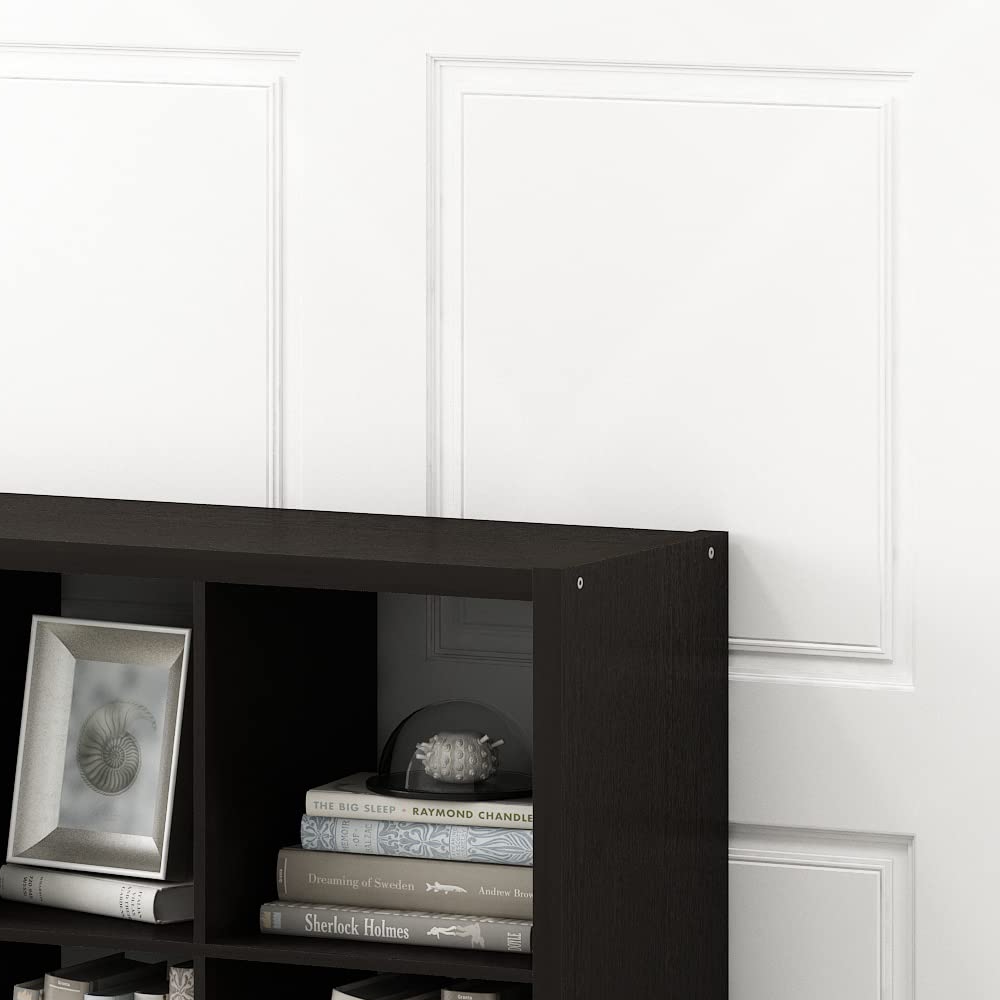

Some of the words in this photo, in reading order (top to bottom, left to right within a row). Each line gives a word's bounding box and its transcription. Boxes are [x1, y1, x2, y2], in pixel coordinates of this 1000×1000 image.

[313, 801, 334, 811] THE
[339, 802, 359, 812] BIG
[364, 804, 396, 814] SLEEP
[412, 807, 473, 819] RAYMOND
[308, 872, 359, 889] Dreaming
[361, 876, 374, 888] of
[375, 877, 415, 891] Sweden
[478, 886, 512, 897] Andrew
[305, 913, 359, 936] Sherlock
[364, 917, 410, 939] Holmes
